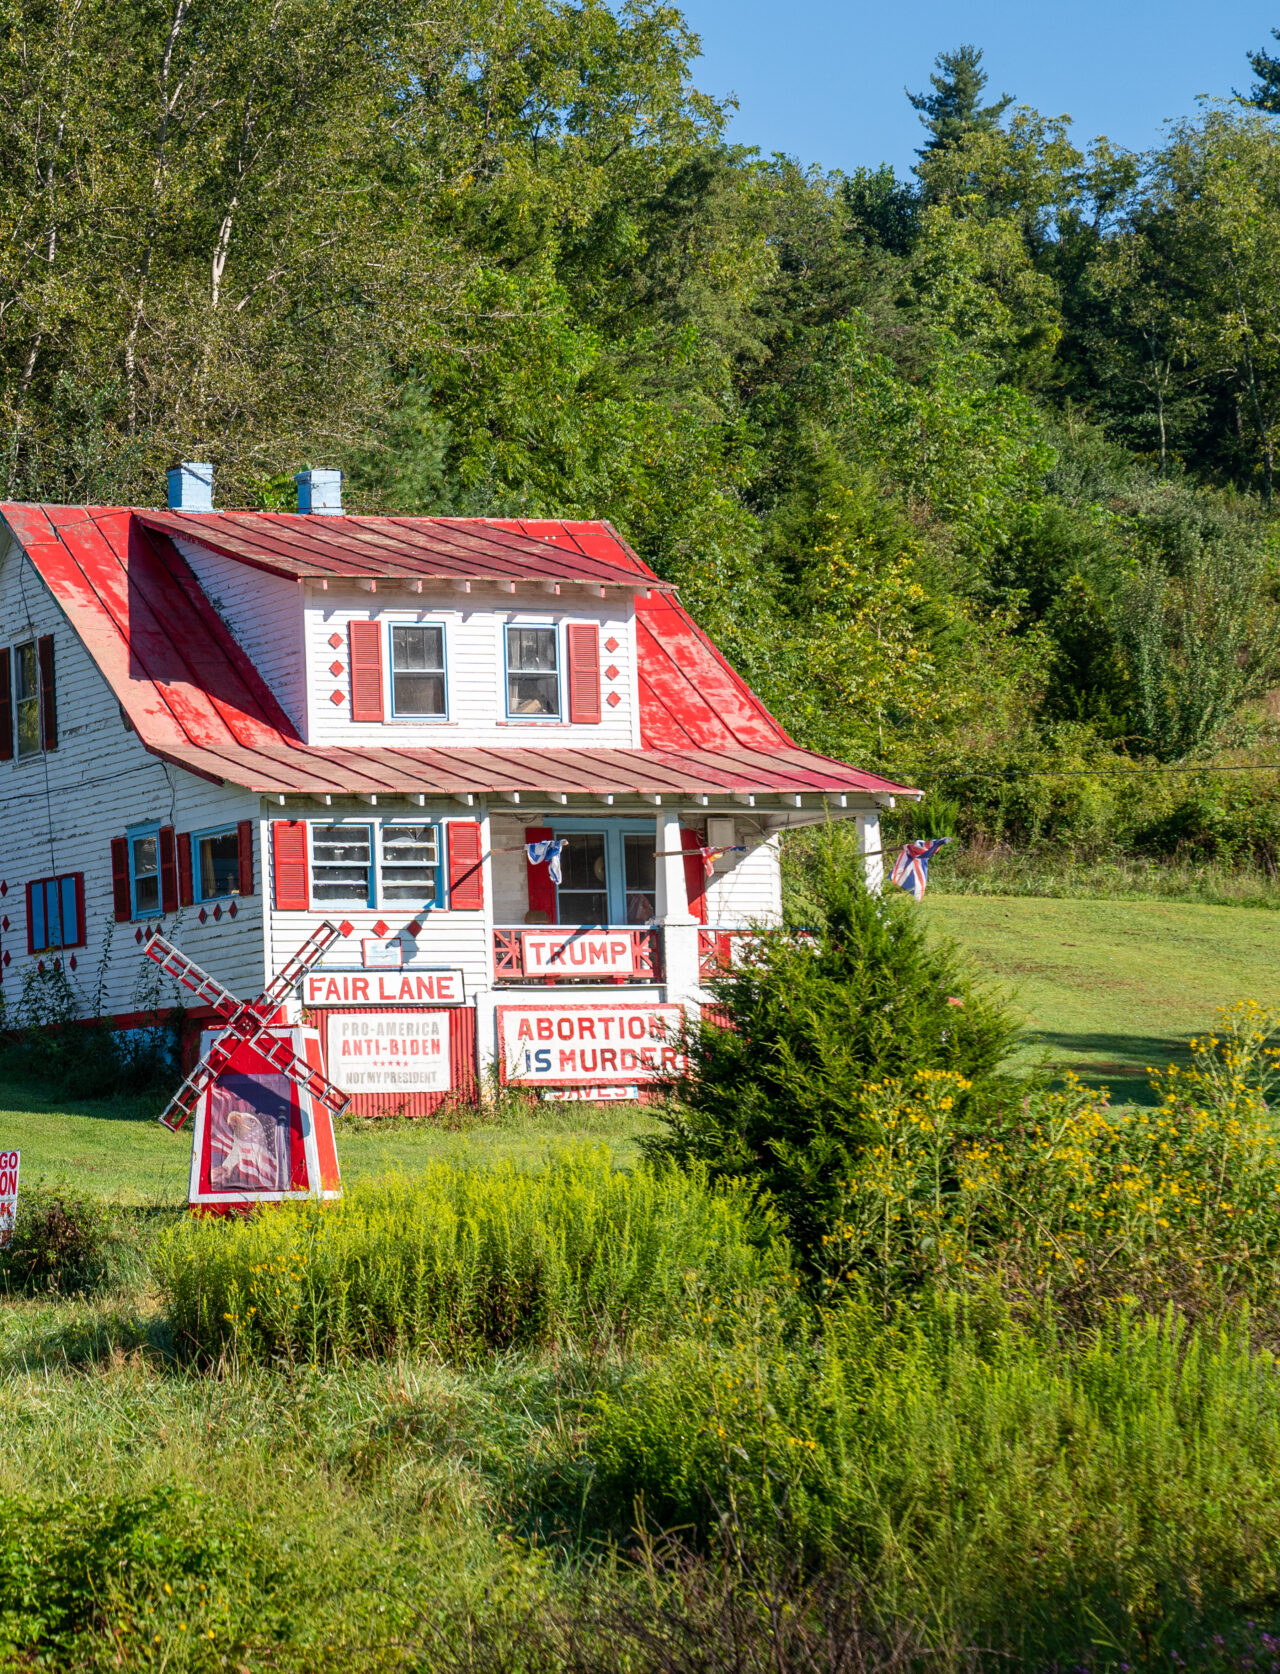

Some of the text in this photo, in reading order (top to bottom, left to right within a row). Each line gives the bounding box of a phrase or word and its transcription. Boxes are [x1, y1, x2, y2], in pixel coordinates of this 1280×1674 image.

[529, 940, 628, 966] TRUMP
[309, 975, 455, 1001] FAIR LANE
[341, 1021, 440, 1036] PRO-AMERICA
[517, 1016, 666, 1041] ABORTION
[341, 1038, 441, 1056] ANTI-BIDEN
[525, 1047, 678, 1073] IS MURDER
[345, 1071, 437, 1084] NOT MY PRESIDENT
[552, 1086, 628, 1099] SAVES
